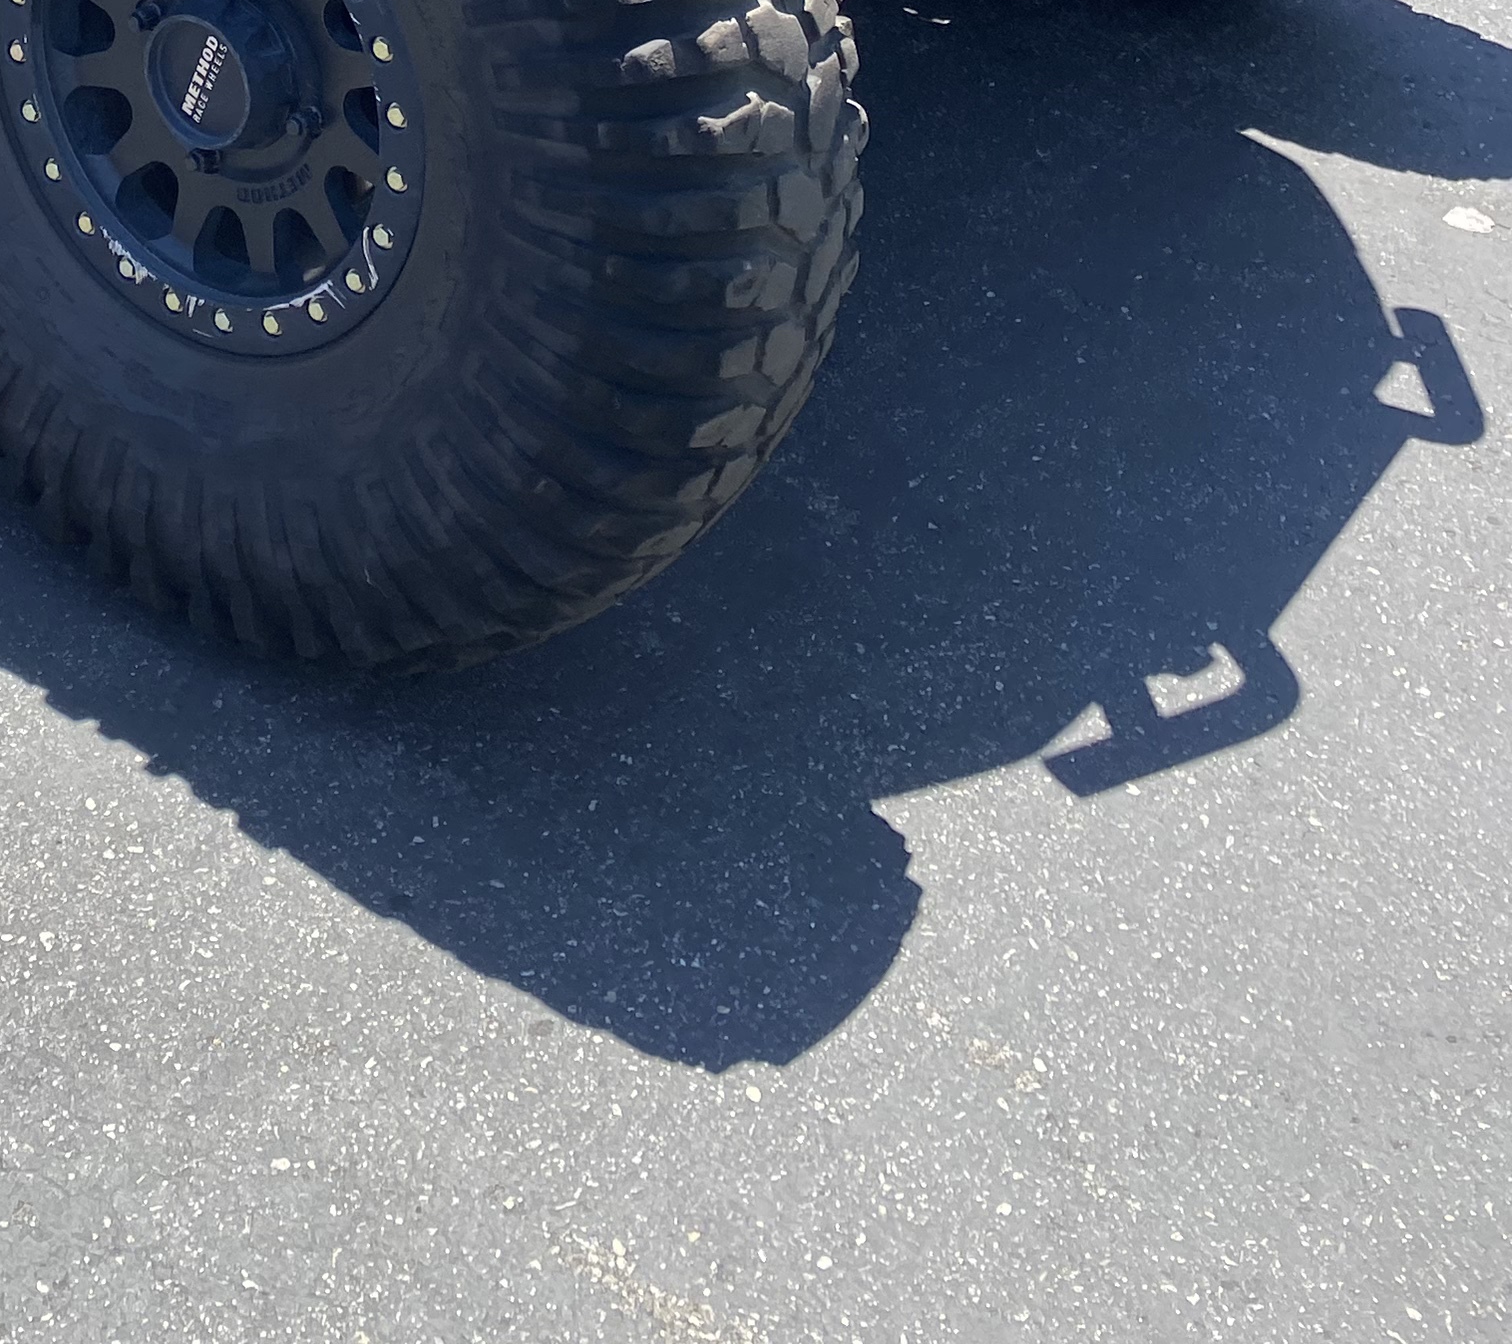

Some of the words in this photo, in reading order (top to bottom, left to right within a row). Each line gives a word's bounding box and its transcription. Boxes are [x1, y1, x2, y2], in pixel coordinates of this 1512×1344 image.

[181, 35, 219, 116] METHOD
[192, 93, 209, 123] RACE
[204, 43, 228, 91] WHEELS
